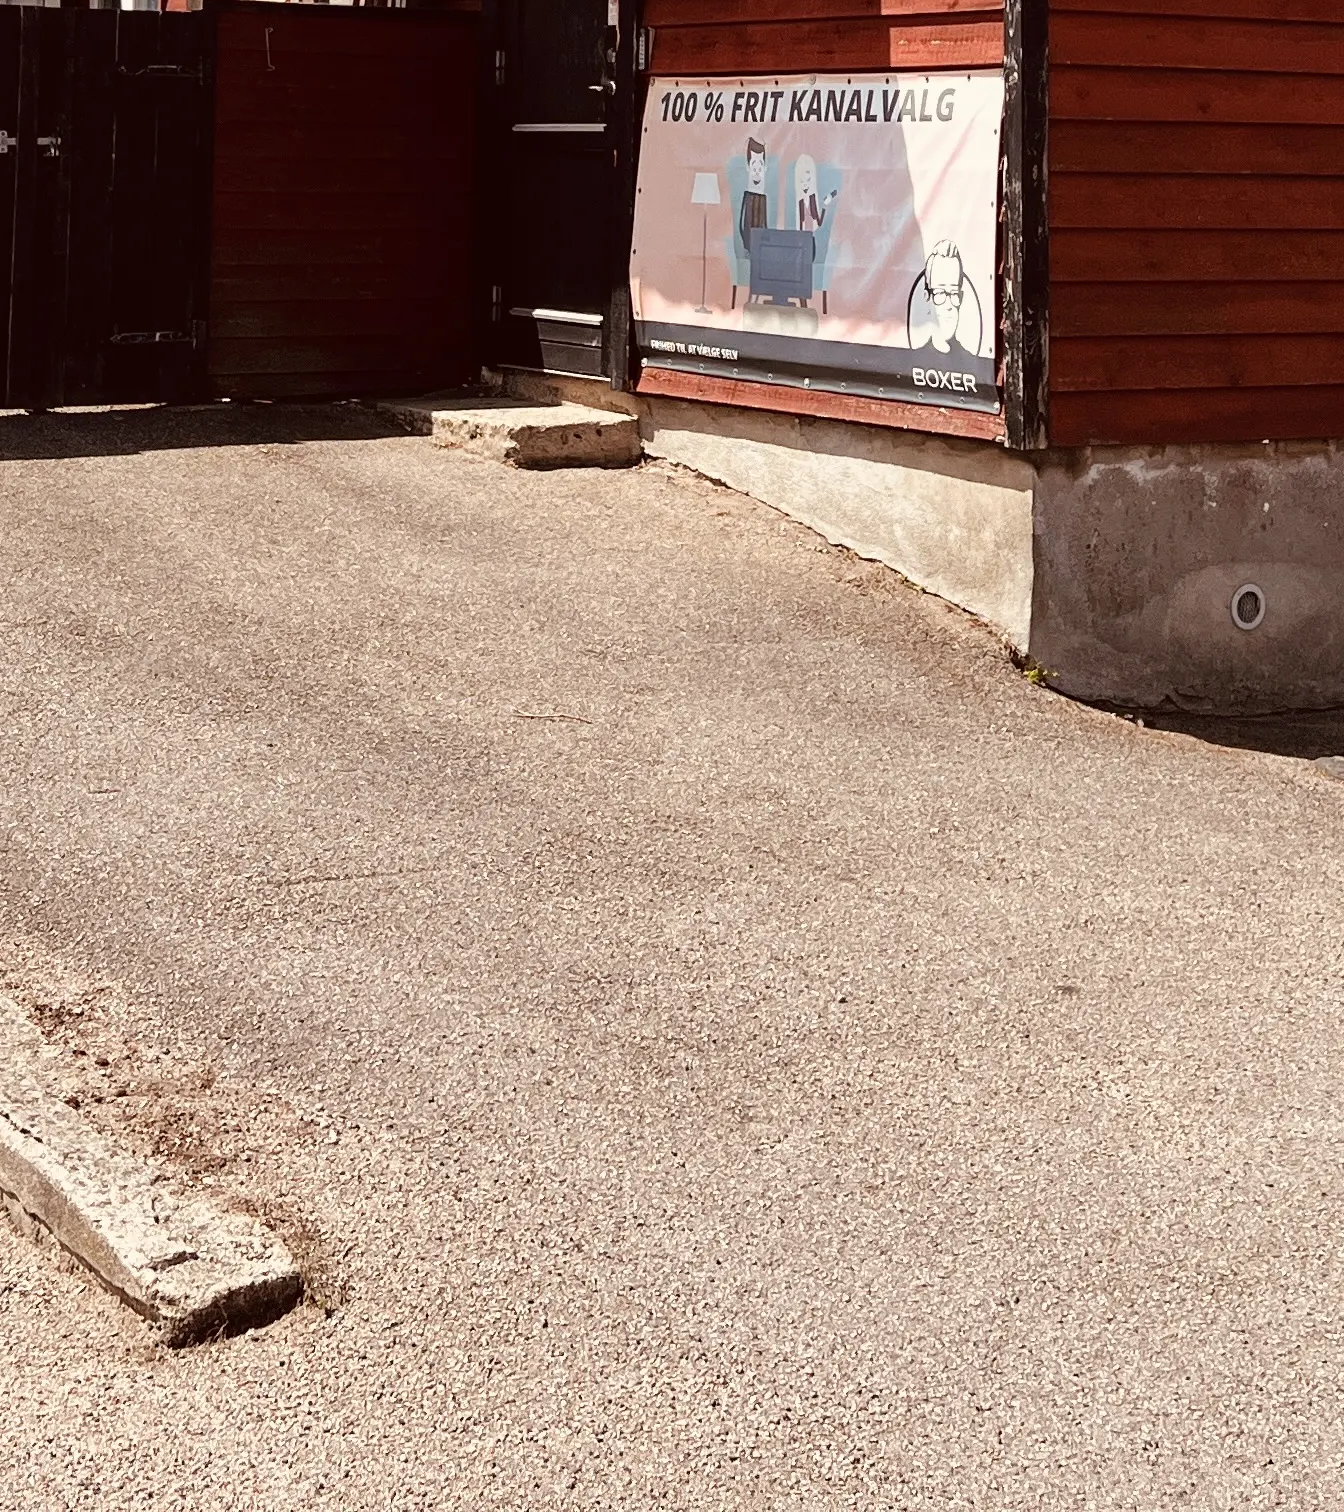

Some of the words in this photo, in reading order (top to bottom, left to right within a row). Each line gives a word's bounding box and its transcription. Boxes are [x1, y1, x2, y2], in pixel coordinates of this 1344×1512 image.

[661, 91, 697, 123] 100
[704, 91, 724, 123] %
[731, 91, 784, 123] FRIT
[788, 88, 956, 123] KANALVALG
[912, 367, 978, 393] BOXER
